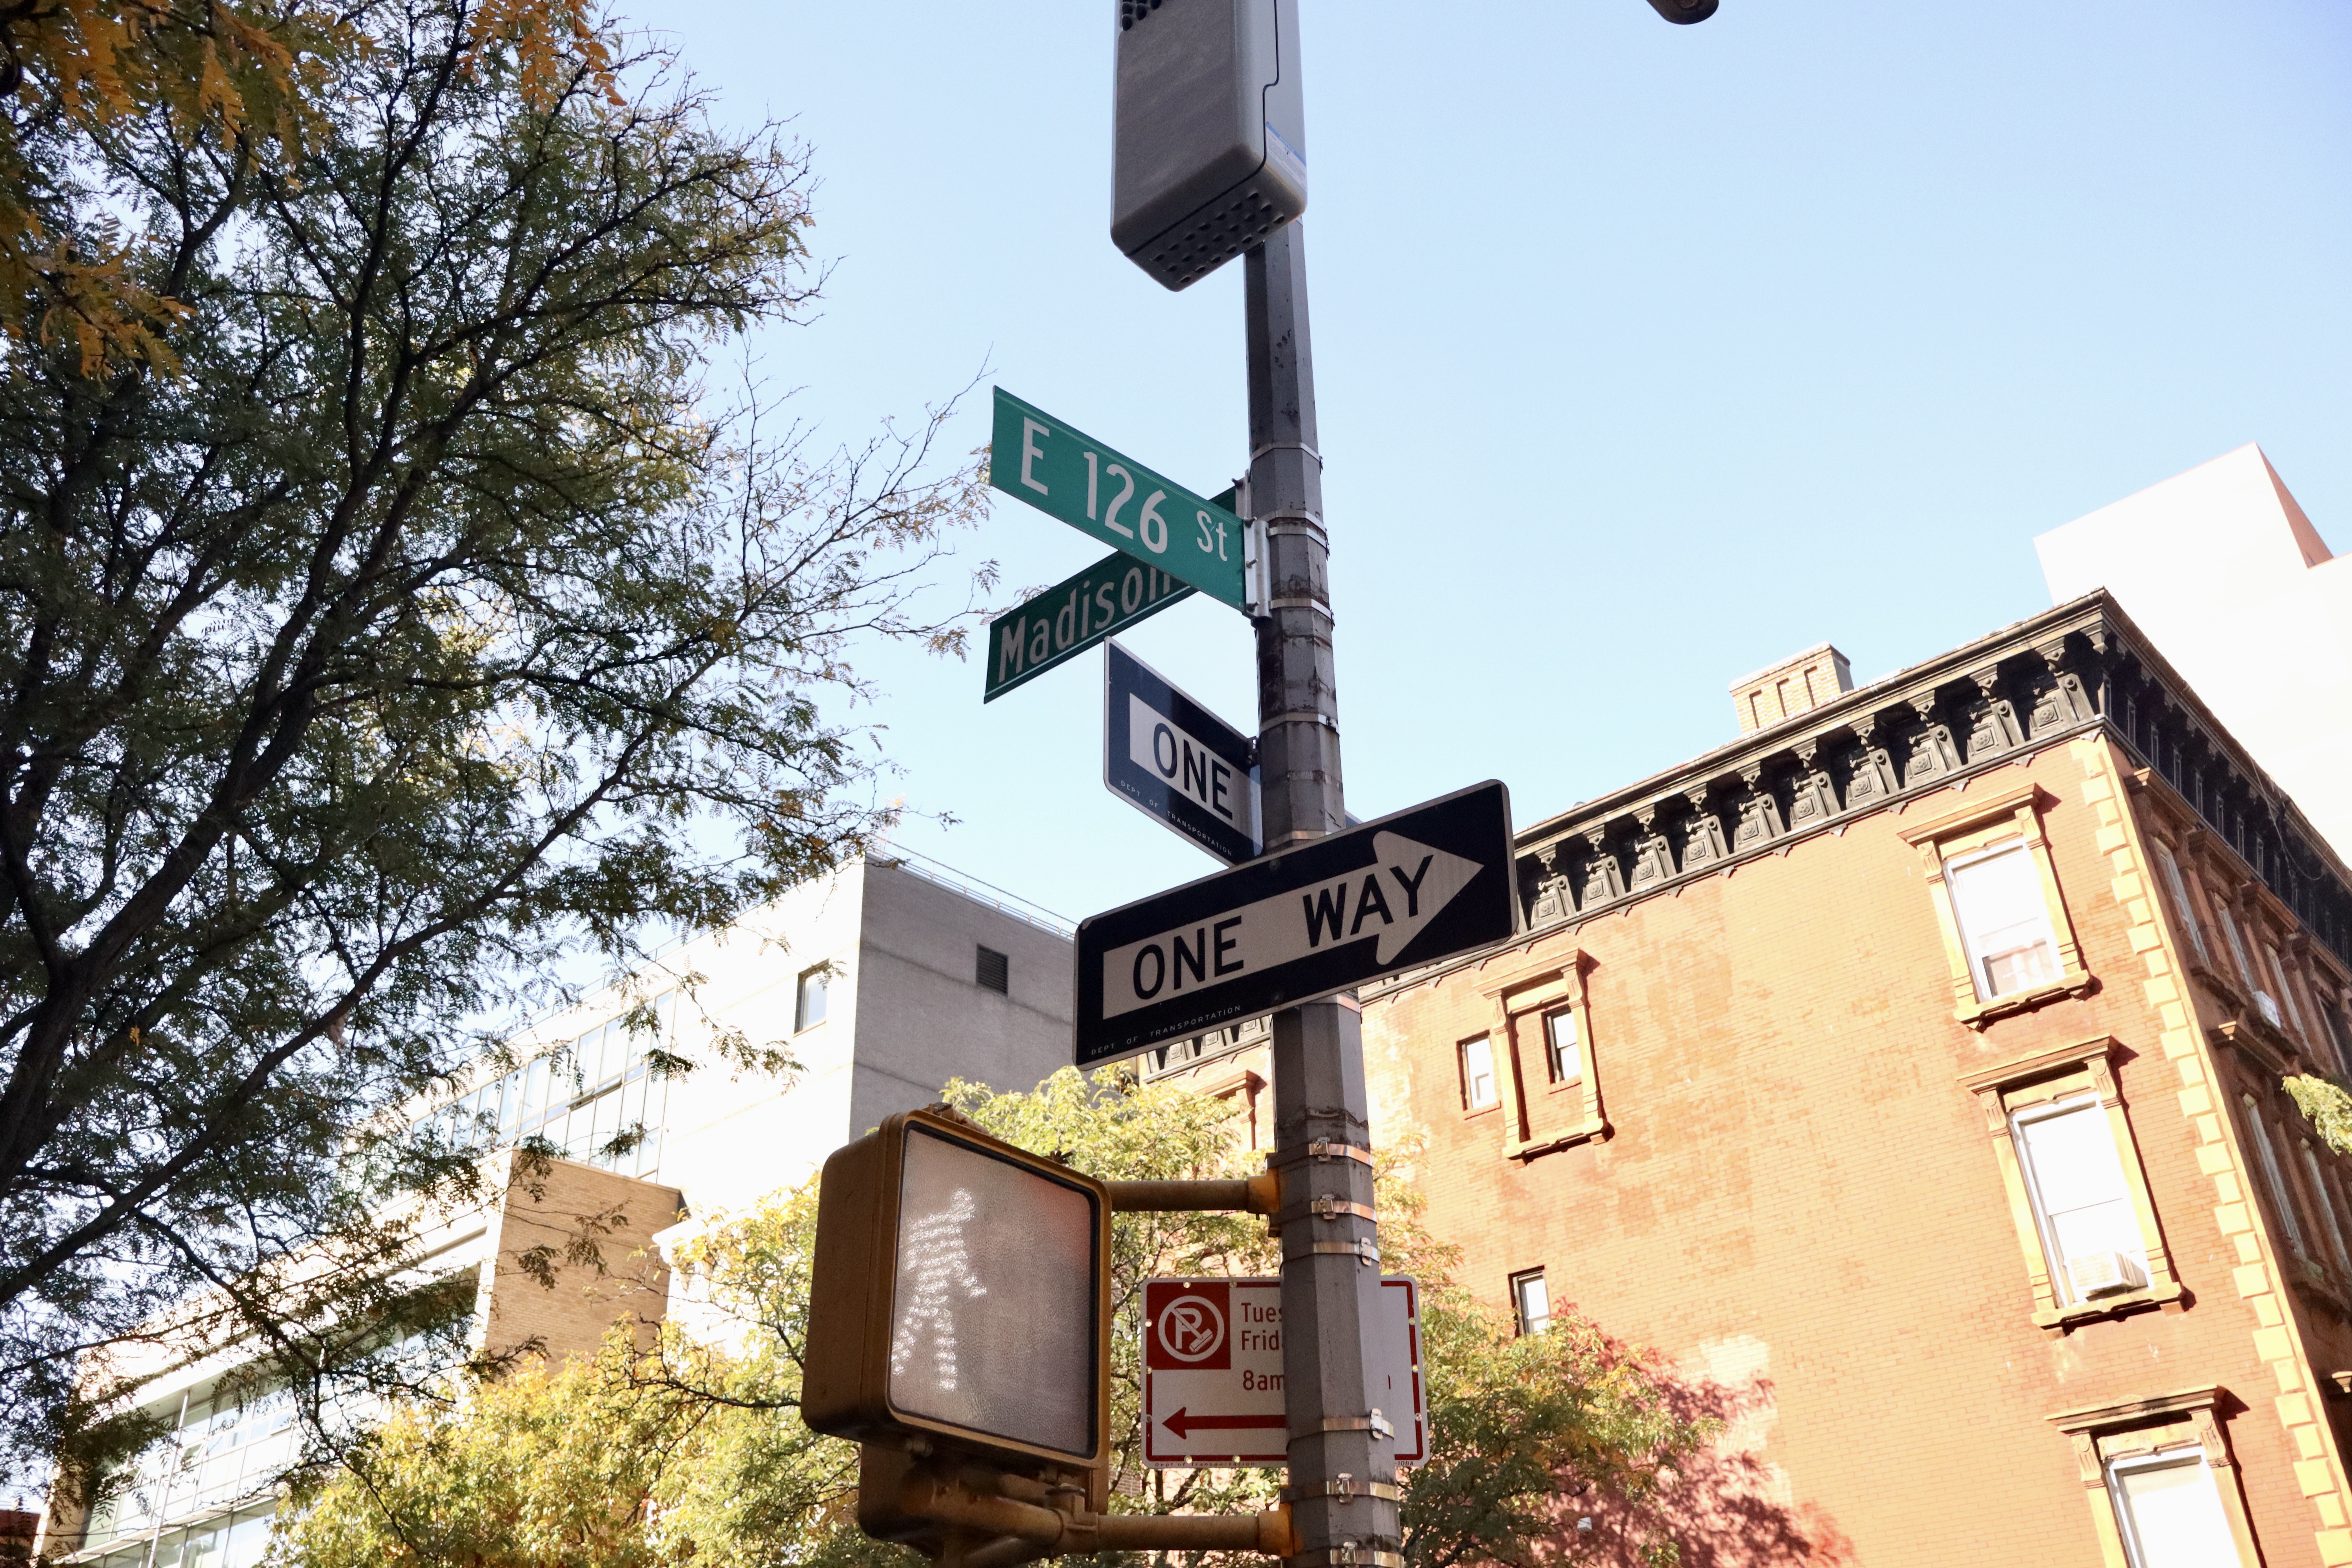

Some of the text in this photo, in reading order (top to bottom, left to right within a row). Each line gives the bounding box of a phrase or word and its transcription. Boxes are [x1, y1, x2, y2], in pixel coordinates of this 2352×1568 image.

[1021, 416, 1228, 562] E 126 St
[1153, 722, 1233, 821] ONE
[1121, 780, 1232, 856] DEPT OF TRANSPORTATION
[1132, 854, 1434, 1000] ONE WAY
[1091, 1005, 1241, 1055] DEPT OF TRANSPORTATION
[1241, 1329, 1280, 1351] Frid
